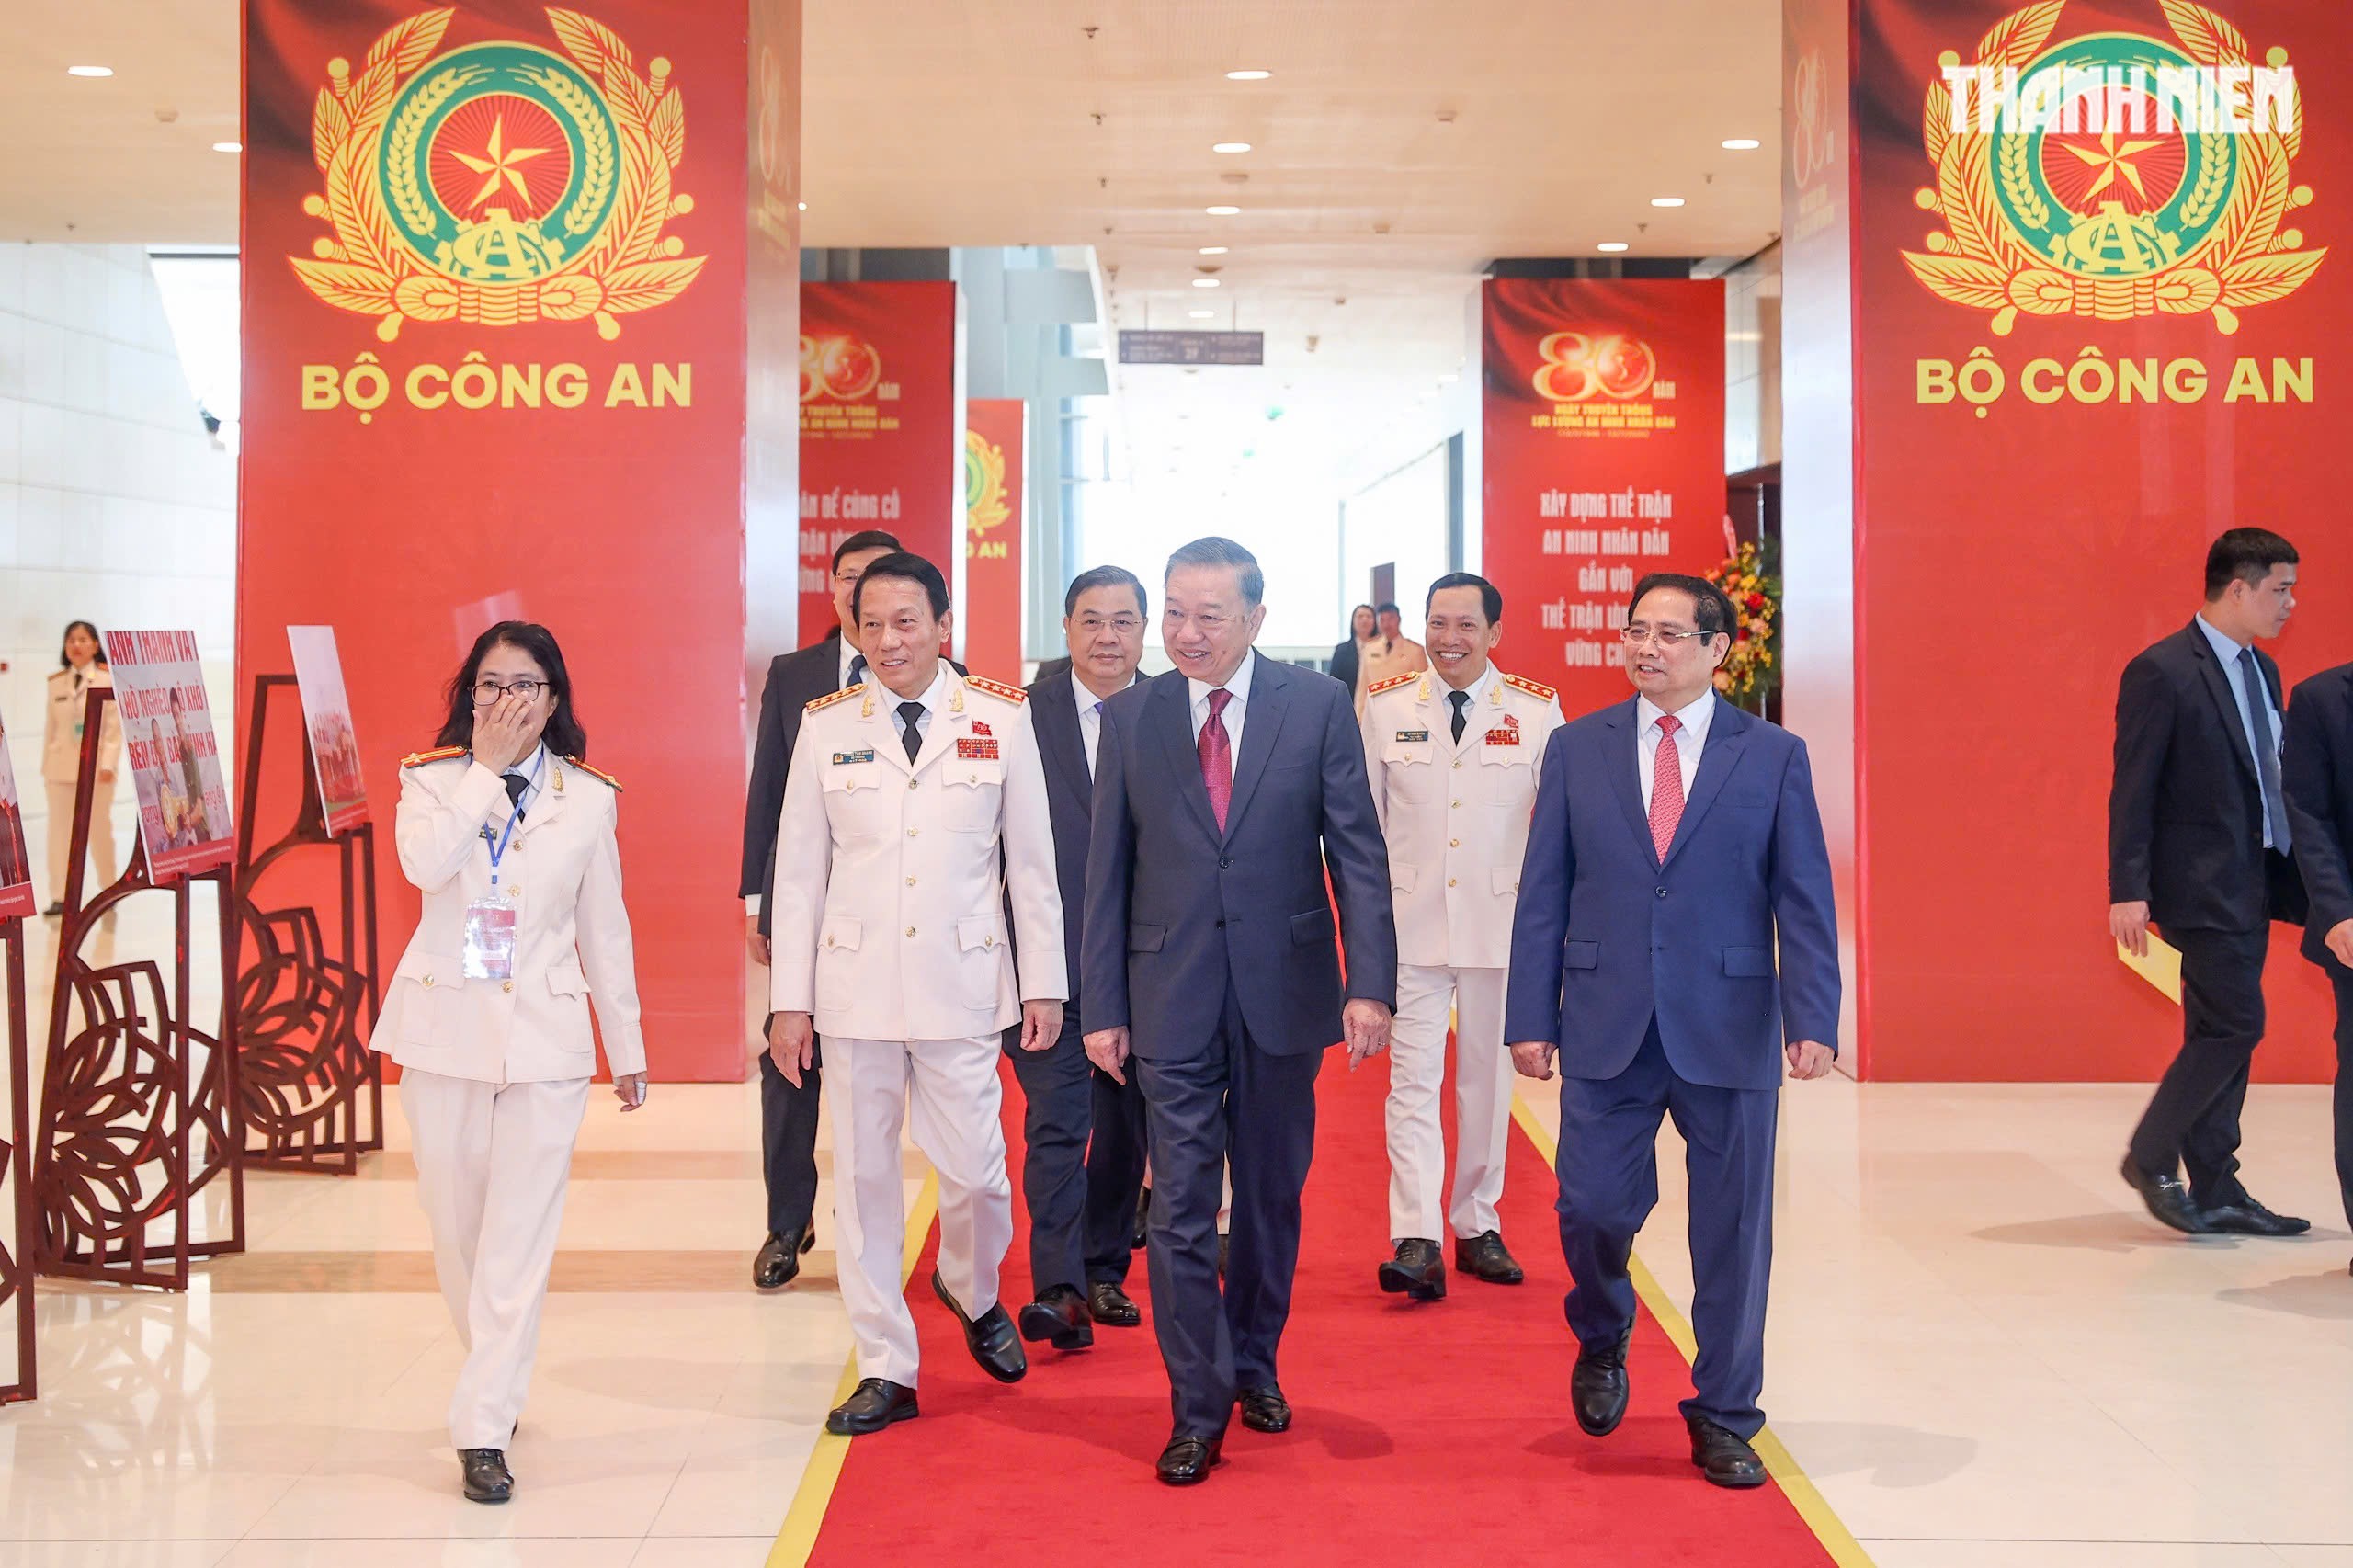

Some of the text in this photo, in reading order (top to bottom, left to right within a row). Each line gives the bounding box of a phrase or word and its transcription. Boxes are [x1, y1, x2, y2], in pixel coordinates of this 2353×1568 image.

[301, 351, 691, 425] BỘ CÔNG AN
[1916, 346, 2313, 419] BỘ CÔNG AN
[1540, 488, 1567, 517] XÂY
[1637, 489, 1672, 524] TRẬN
[978, 541, 1007, 559] AN
[1542, 529, 1562, 554] AN
[1564, 529, 1597, 554] NINH
[1601, 526, 1638, 555] NHÂN
[1569, 600, 1603, 635] TRẬN
